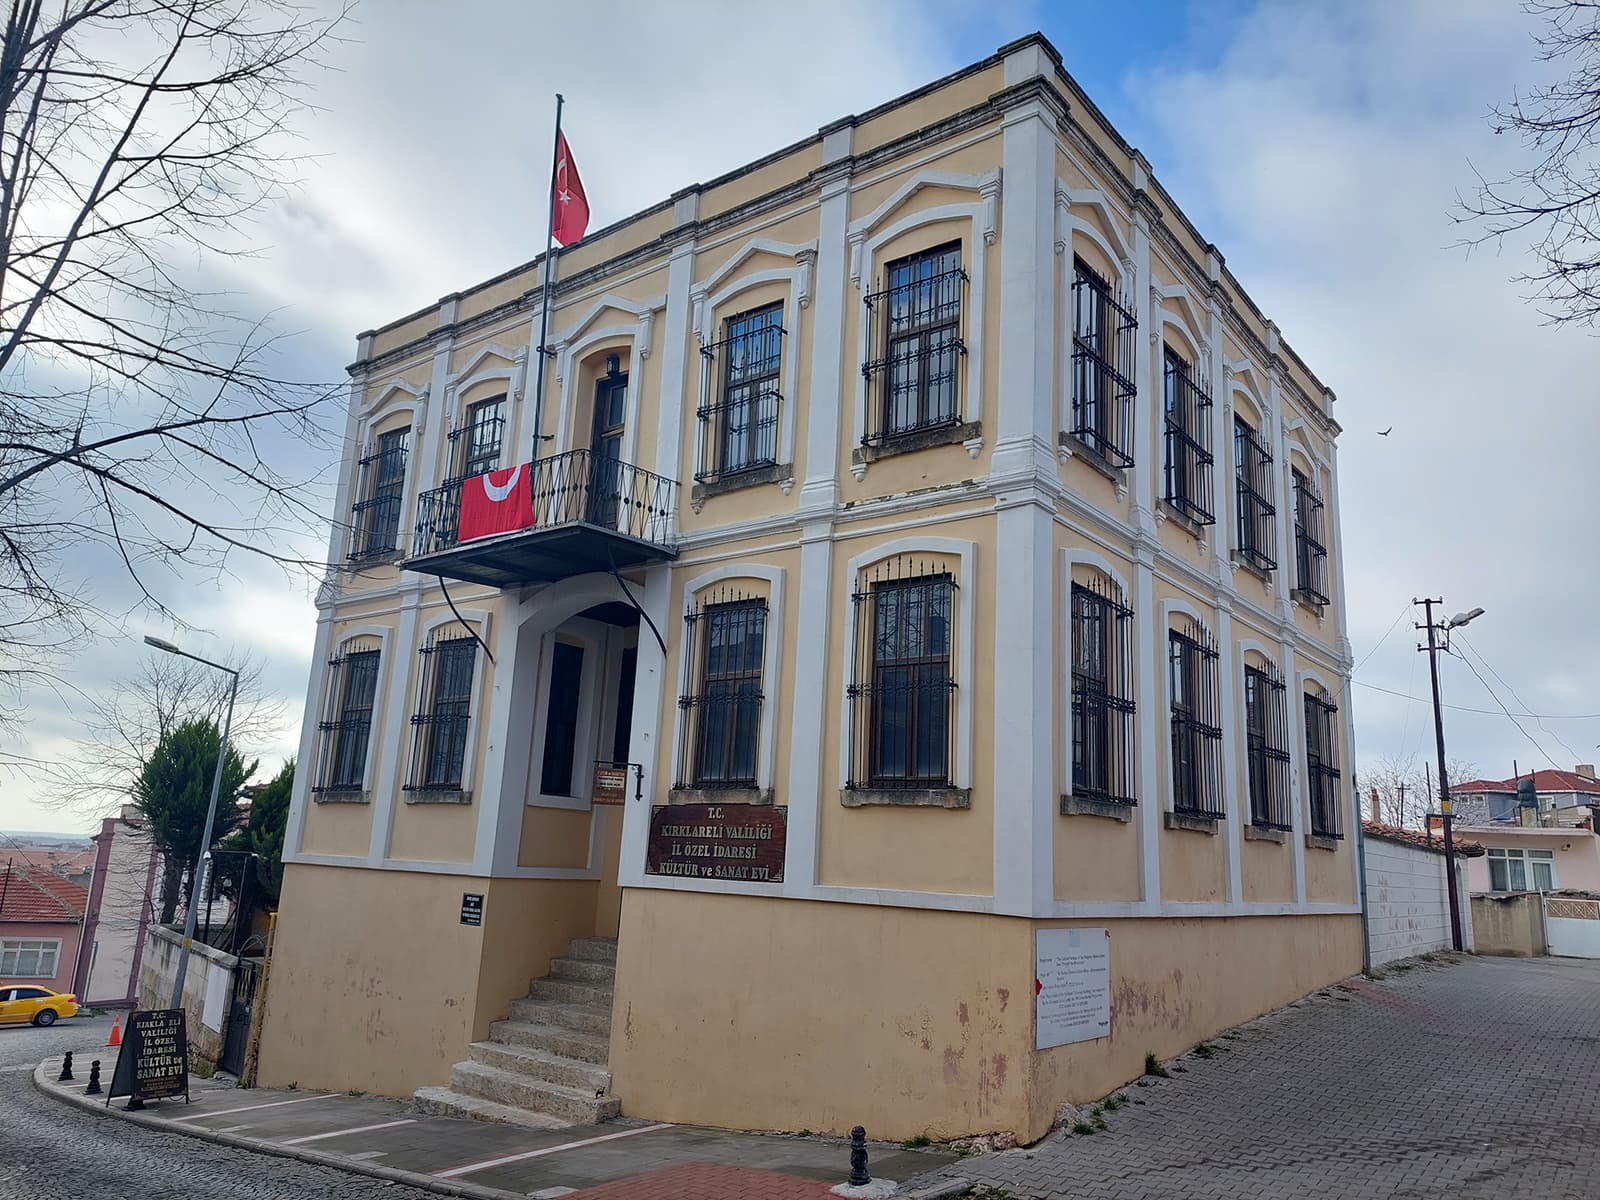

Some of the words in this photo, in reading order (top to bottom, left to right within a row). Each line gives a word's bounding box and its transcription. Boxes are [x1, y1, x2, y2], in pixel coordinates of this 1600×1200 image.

[708, 807, 725, 819] T.C.
[661, 823, 723, 838] KIRKLARELİ
[726, 824, 773, 840] VALİLİĞİ
[672, 841, 682, 856] İL
[684, 841, 710, 857] ÖZEL
[713, 842, 757, 859] İDARESİ
[660, 860, 698, 876] KÜLTÜR
[701, 867, 713, 876] ve
[715, 865, 748, 879] SANAT
[751, 864, 769, 880] EVİ
[137, 1054, 171, 1068] KÜLTÜR
[137, 1066, 166, 1080] SANAT
[168, 1065, 183, 1076] EVİ
